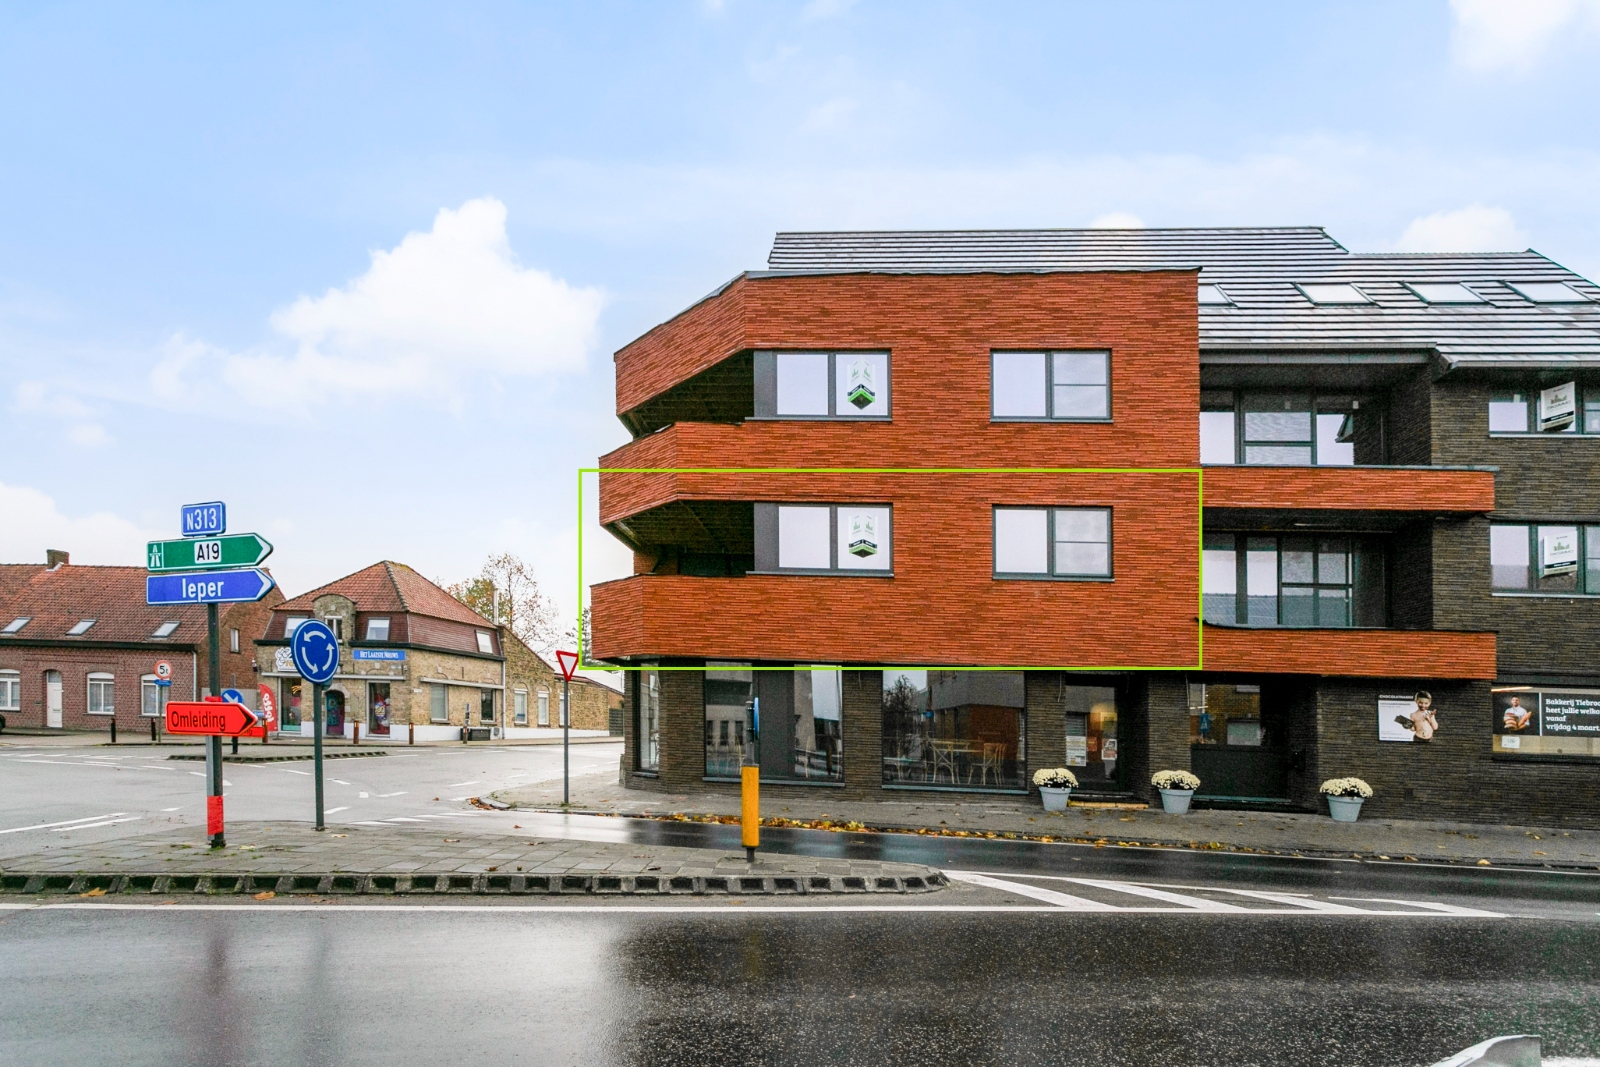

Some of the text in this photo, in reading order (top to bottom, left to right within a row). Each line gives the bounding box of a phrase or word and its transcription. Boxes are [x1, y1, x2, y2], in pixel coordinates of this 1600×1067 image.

[186, 507, 217, 531] N313
[196, 543, 220, 561] A19
[181, 578, 225, 603] Ieper
[1545, 698, 1574, 706] Bakkerij
[171, 710, 226, 732] Omleiding
